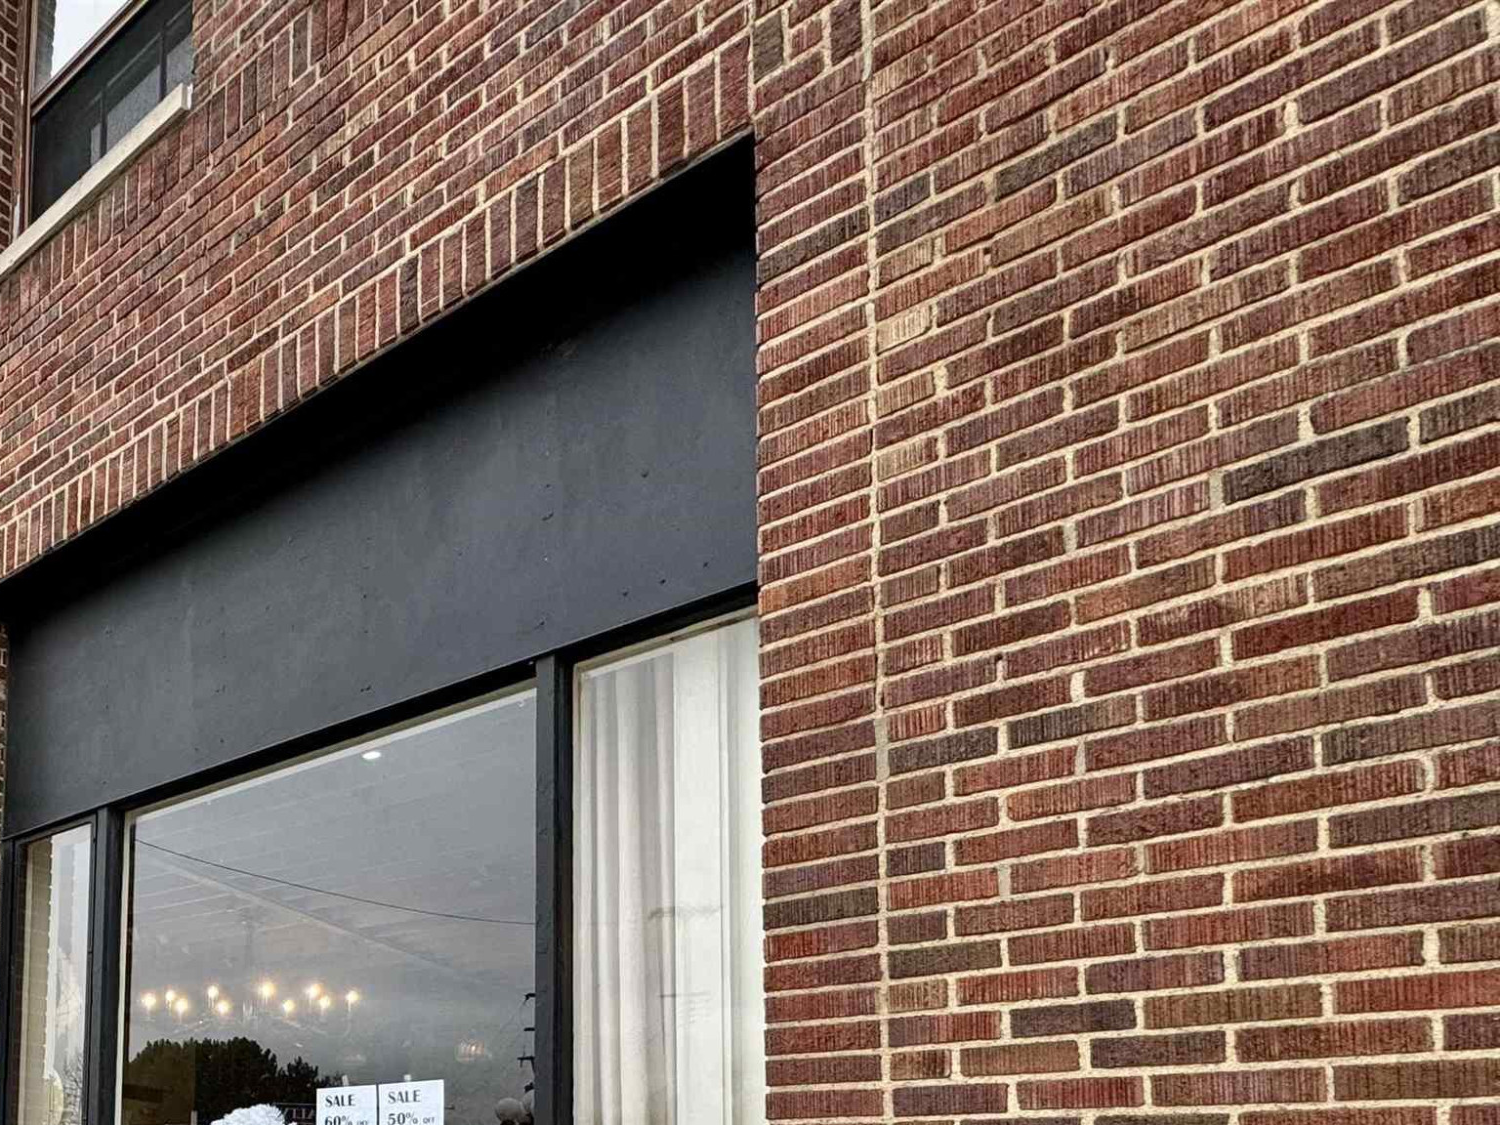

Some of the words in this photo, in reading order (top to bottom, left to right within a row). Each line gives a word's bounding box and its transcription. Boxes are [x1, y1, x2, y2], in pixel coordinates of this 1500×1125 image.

[325, 1094, 356, 1107] SALE
[388, 1090, 421, 1104] SALE
[387, 1112, 418, 1125] 50%
